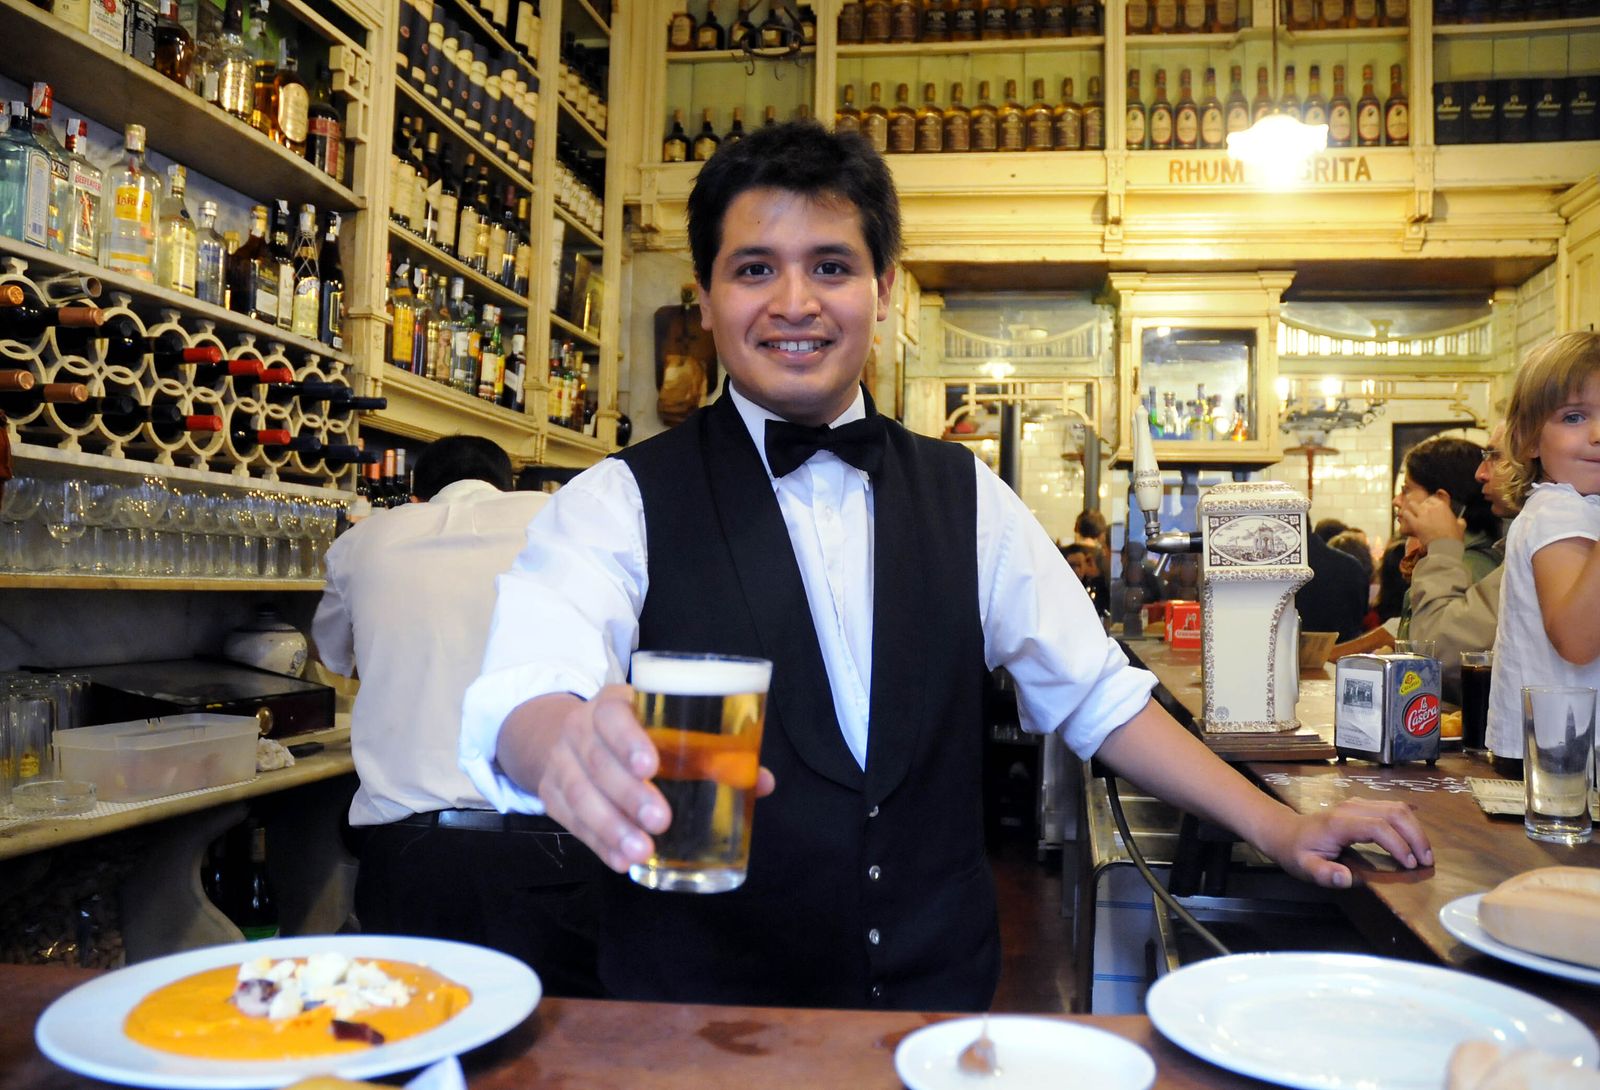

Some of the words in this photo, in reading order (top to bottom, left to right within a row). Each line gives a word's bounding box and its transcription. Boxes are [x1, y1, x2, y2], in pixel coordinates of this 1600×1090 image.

[1168, 159, 1245, 184] RHUM
[1418, 697, 1428, 713] La
[1408, 705, 1438, 732] Casera
